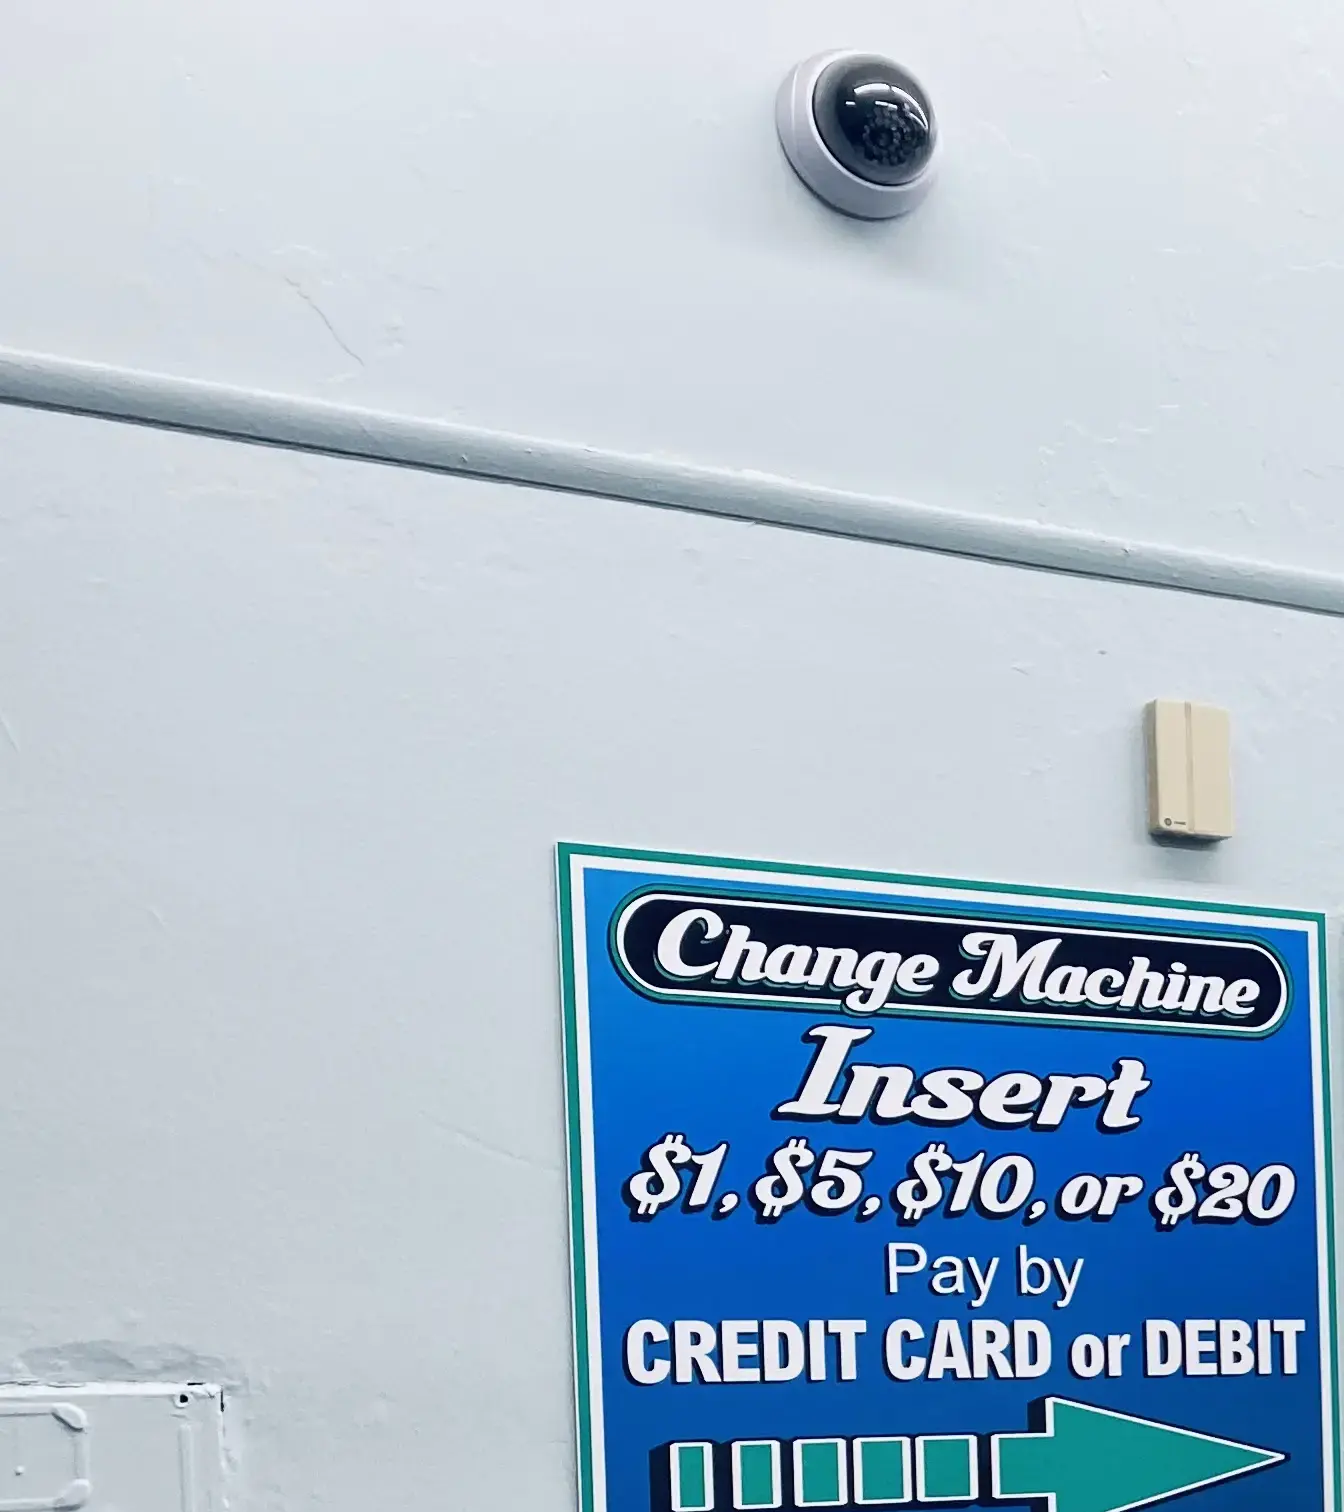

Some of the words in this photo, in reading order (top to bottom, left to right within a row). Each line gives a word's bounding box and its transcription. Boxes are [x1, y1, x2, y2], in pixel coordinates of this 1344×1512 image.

[656, 908, 940, 1012] Change
[952, 931, 1261, 1015] Machine
[777, 1025, 1150, 1128] Insert
[629, 1134, 738, 1215] $1,
[755, 1138, 881, 1217] $5,
[896, 1143, 1046, 1220] $10,
[1061, 1175, 1144, 1216] or
[1154, 1152, 1296, 1225] $20
[888, 1242, 999, 1306] Pay
[1020, 1244, 1084, 1308] by
[626, 1318, 866, 1385] CREDIT
[885, 1318, 1052, 1381] CARD
[1071, 1332, 1131, 1379] or
[1146, 1319, 1306, 1378] DEBIT
